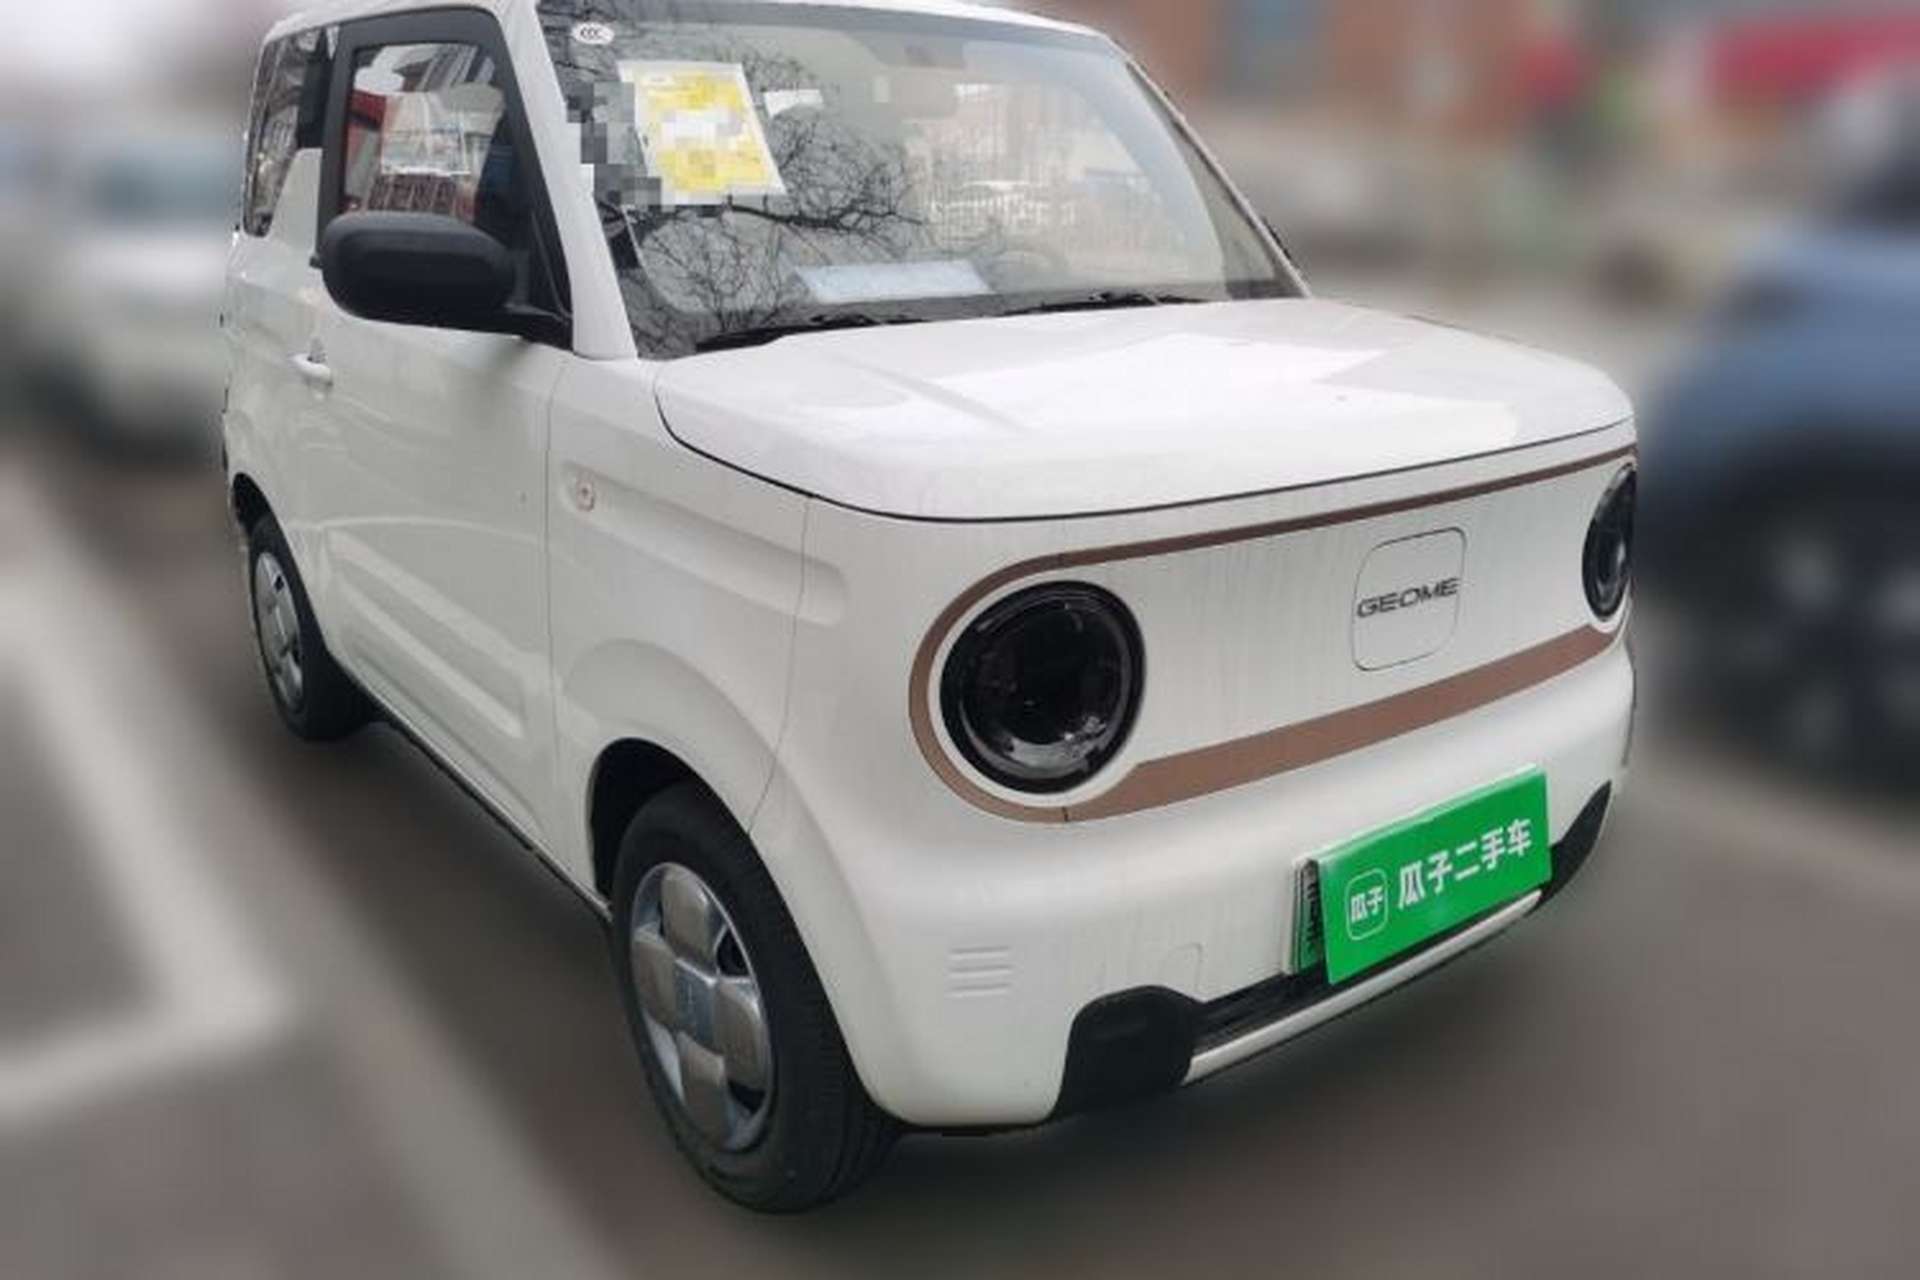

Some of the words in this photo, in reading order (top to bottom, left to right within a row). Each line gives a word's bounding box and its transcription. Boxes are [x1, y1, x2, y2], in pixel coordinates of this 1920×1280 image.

[1357, 577, 1460, 618] GEOME
[1397, 818, 1532, 909] 瓜子二手车
[1350, 885, 1384, 923] 瓜子
